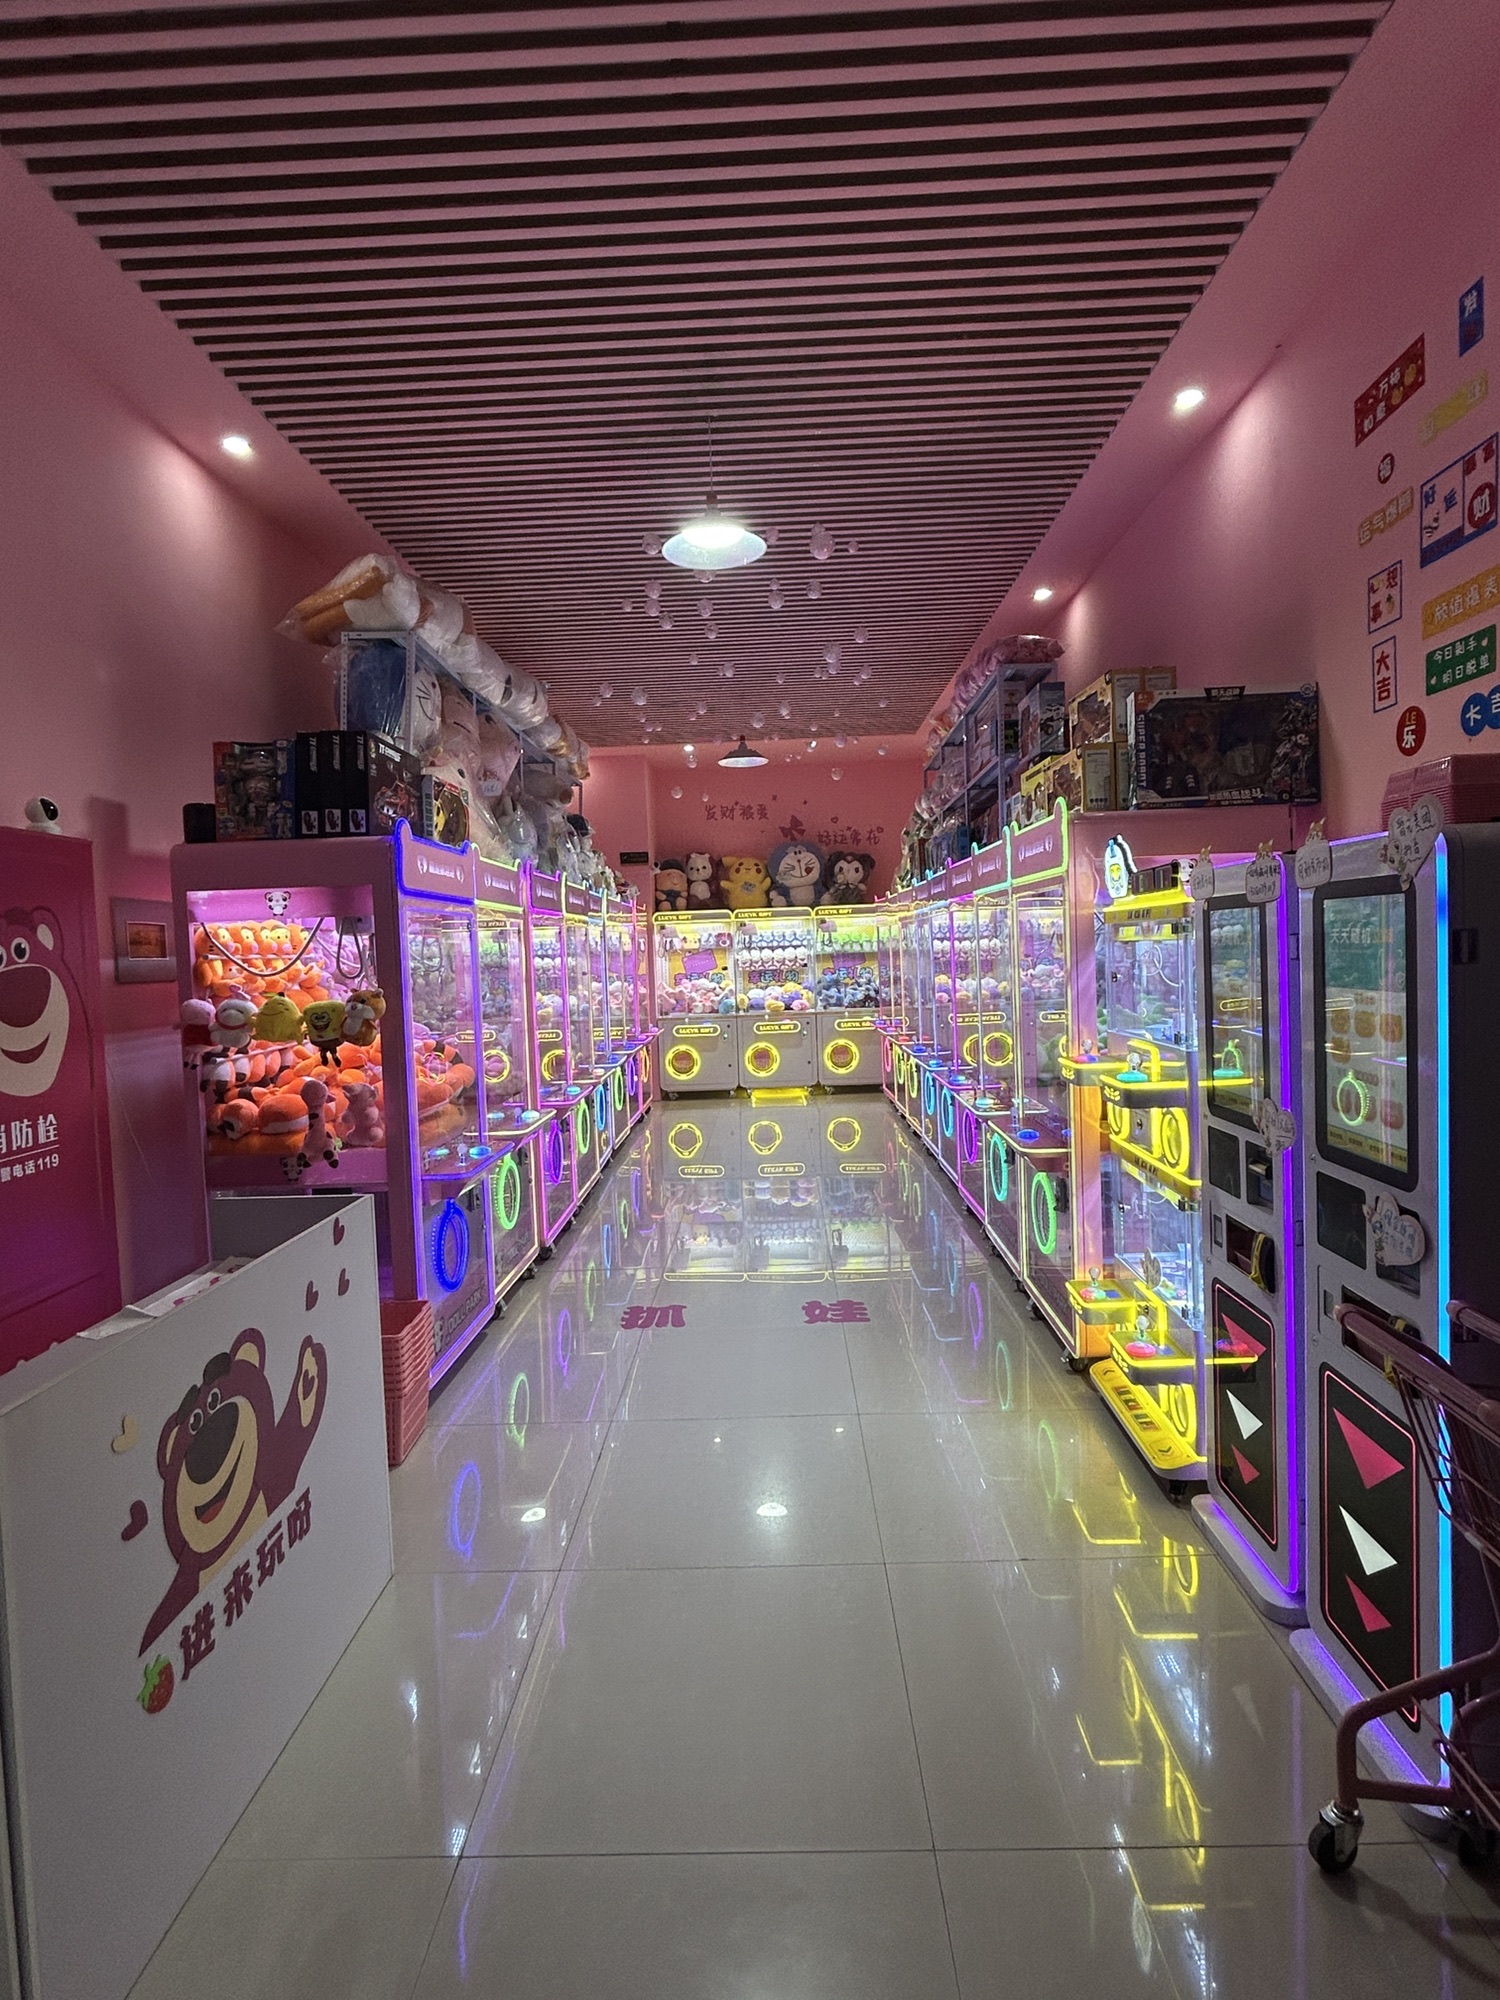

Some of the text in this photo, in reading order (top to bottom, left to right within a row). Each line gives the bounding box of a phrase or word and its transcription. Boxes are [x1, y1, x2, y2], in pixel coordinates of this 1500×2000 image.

[1434, 575, 1498, 624] 颜值爆表
[1433, 635, 1478, 664] 今日剁手
[1376, 650, 1391, 701] 大吉
[1442, 653, 1490, 684] 明日脱单
[1405, 711, 1417, 725] LE
[1402, 725, 1416, 749] 乐
[816, 828, 881, 846] 好运常在
[621, 1300, 871, 1330] 抓 娃
